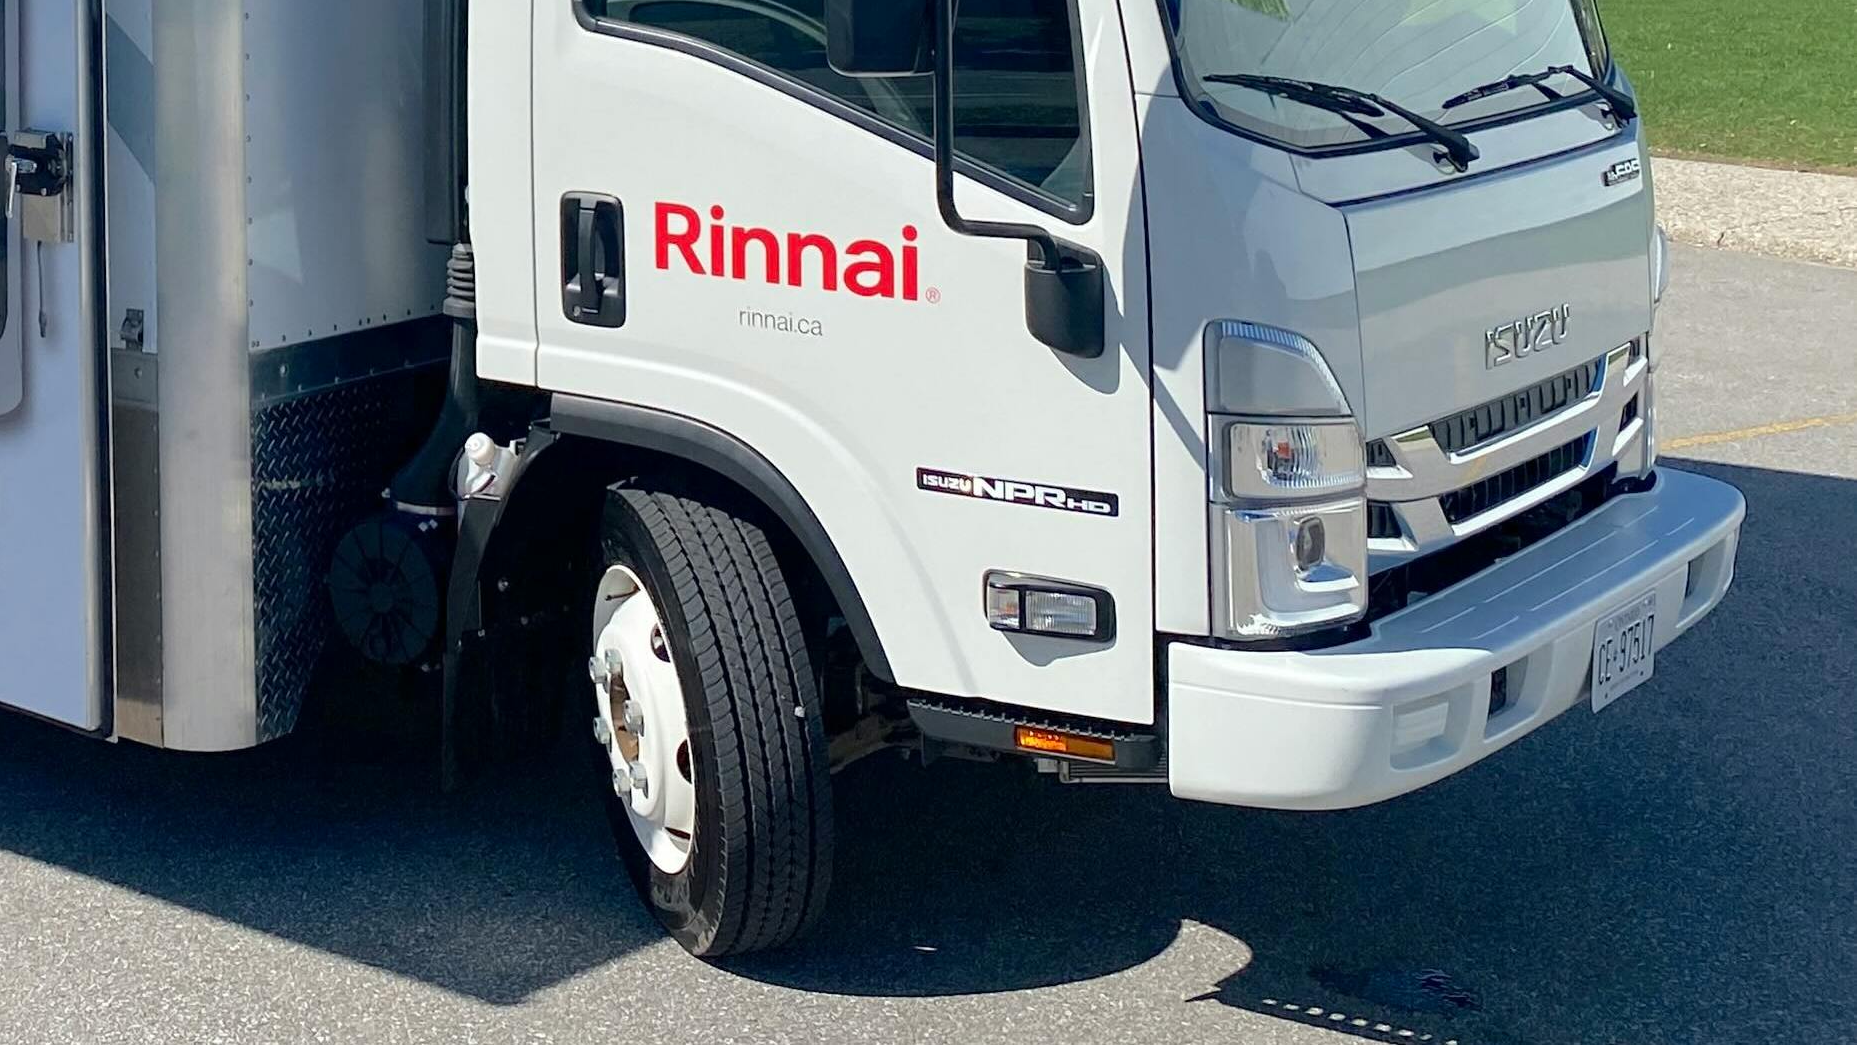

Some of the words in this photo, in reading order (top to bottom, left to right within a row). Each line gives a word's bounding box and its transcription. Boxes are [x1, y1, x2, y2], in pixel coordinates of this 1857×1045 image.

[654, 201, 919, 302] Rinnai
[739, 306, 823, 336] rinnai.ca
[1485, 303, 1570, 370] ISUZU
[922, 473, 973, 492] ISUZU
